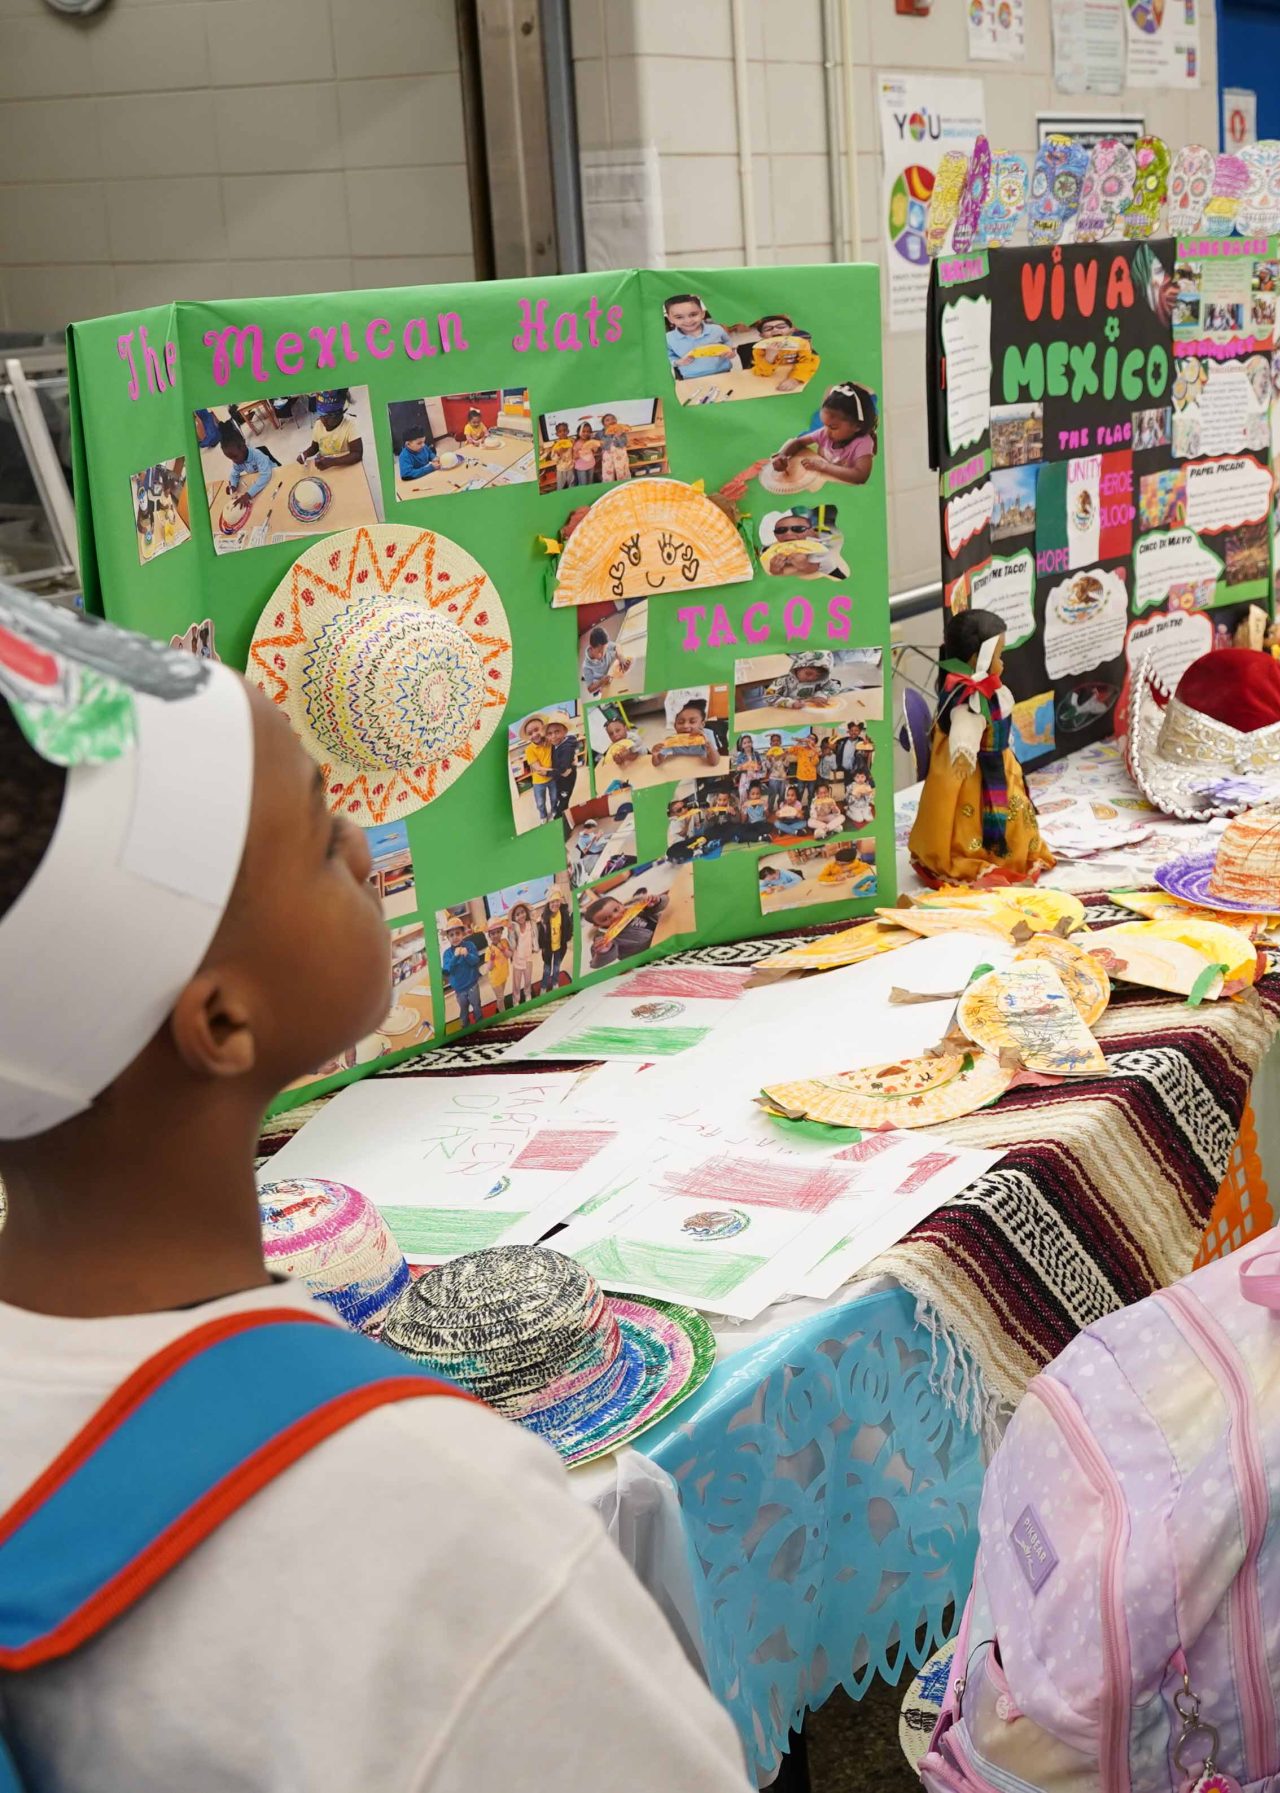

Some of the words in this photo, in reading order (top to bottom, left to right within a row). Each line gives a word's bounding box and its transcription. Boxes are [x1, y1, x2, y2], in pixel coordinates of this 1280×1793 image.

[1021, 245, 1134, 321] VIVA
[117, 325, 177, 400] The
[203, 311, 468, 386] Mexican
[512, 296, 623, 353] Hats
[1003, 316, 1168, 403] MEXICO
[1058, 428, 1089, 450] THE
[1097, 422, 1132, 446] FLAG
[1067, 458, 1102, 483] UNITY
[1190, 466, 1214, 478] PAPEL
[1217, 461, 1245, 472] PICADO
[1036, 547, 1070, 574] HOPE
[1140, 541, 1158, 554] CINCO
[677, 595, 853, 652] TACOS
[1023, 1517, 1047, 1564] PIKBEAR
